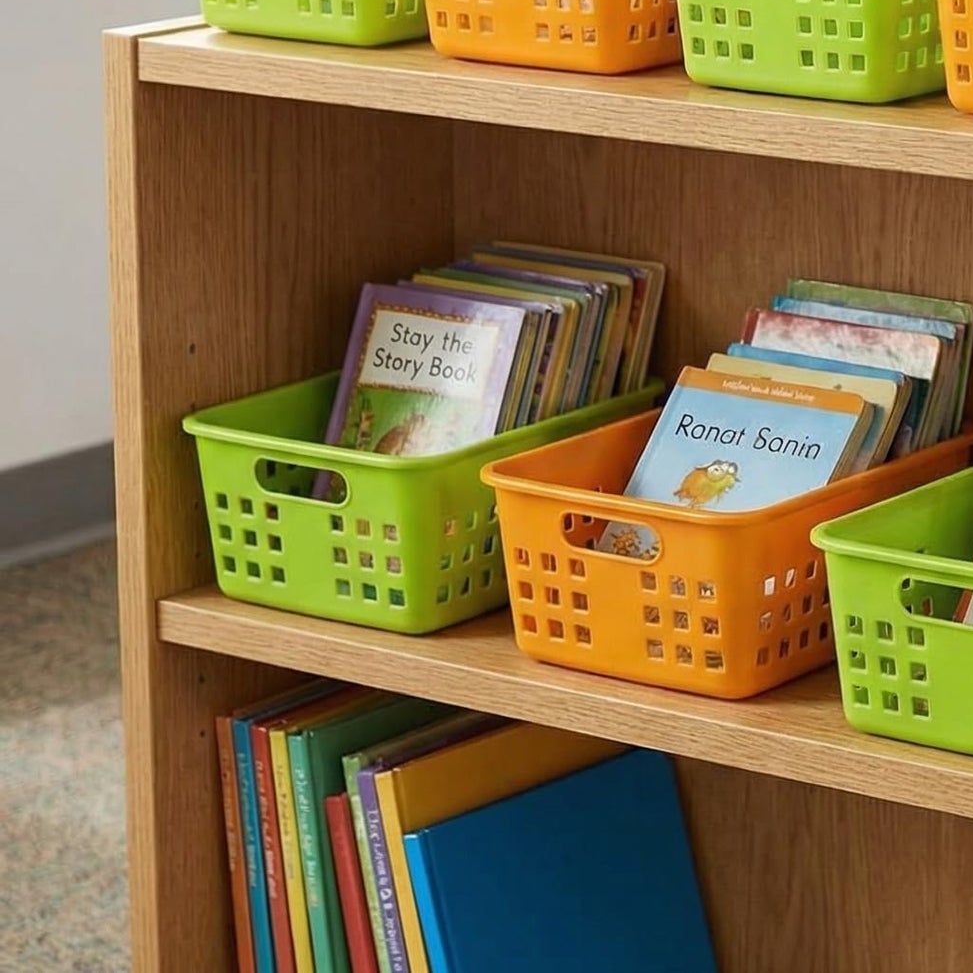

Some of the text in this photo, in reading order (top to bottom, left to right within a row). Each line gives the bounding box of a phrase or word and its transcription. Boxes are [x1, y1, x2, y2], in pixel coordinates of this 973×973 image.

[391, 323, 474, 355] Stay the
[372, 347, 476, 383] Story Book
